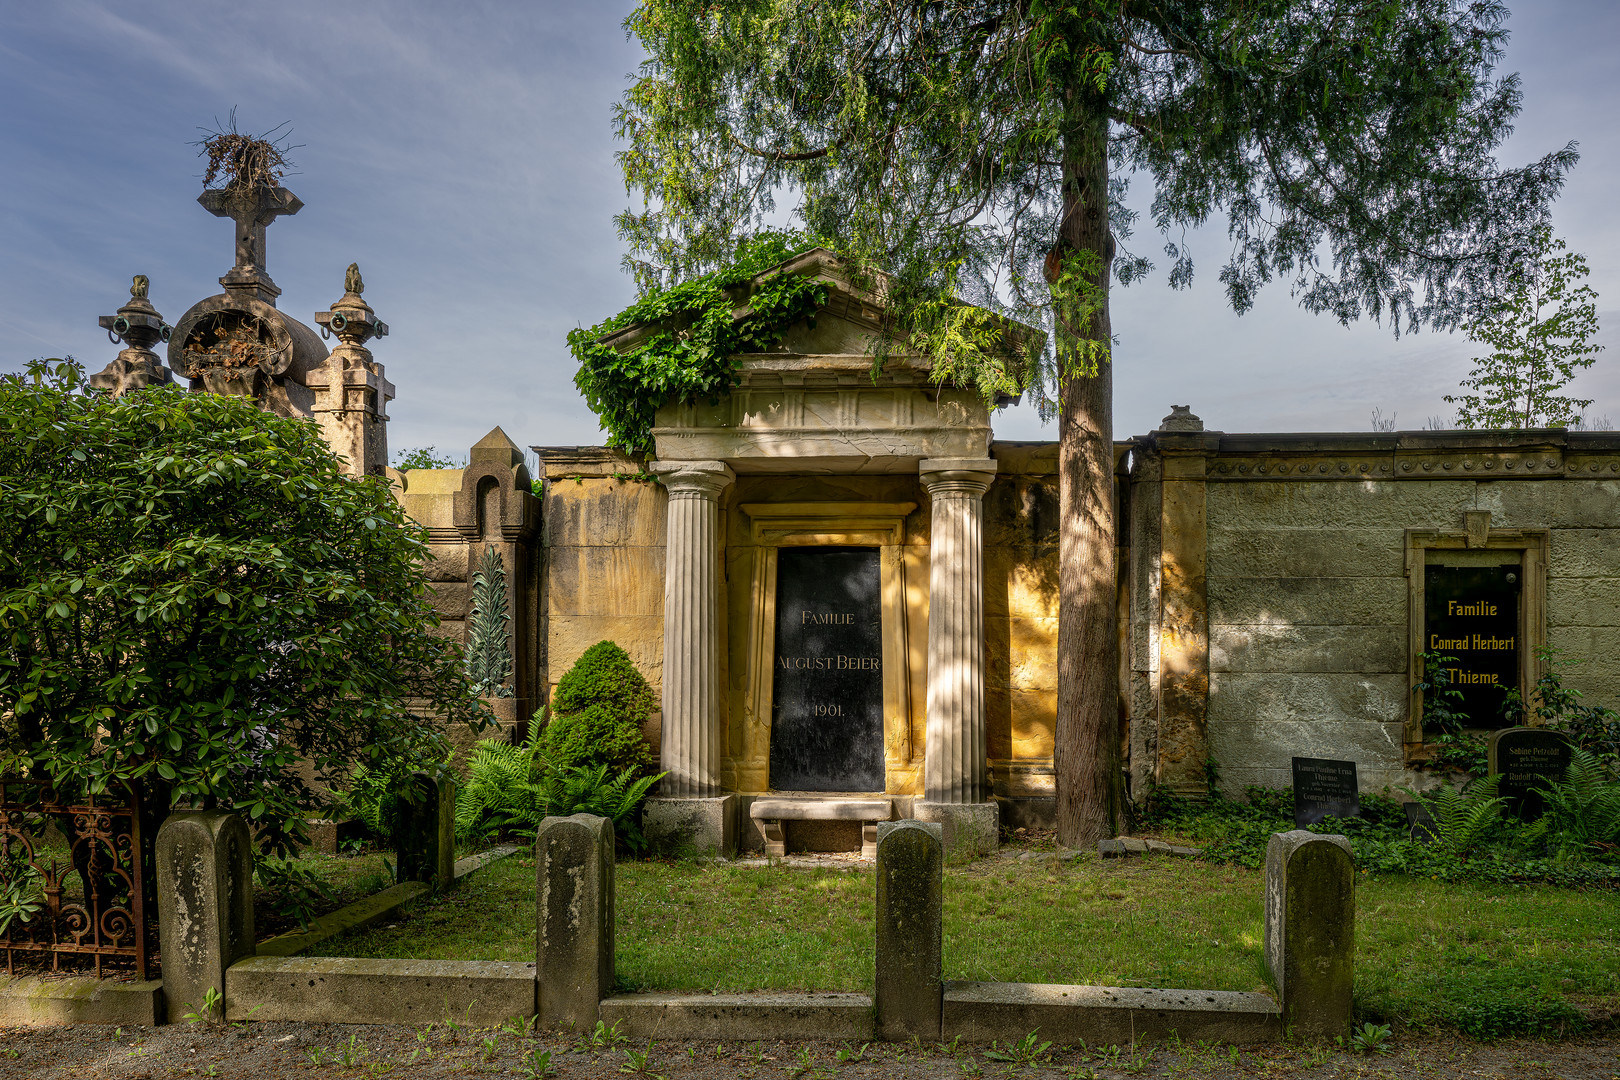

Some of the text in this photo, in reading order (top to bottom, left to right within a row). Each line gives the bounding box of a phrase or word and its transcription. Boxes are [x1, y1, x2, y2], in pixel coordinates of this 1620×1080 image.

[1448, 600, 1498, 616] Familie
[1430, 633, 1515, 650] Conrad Herbert
[1446, 668, 1499, 684] Thieme
